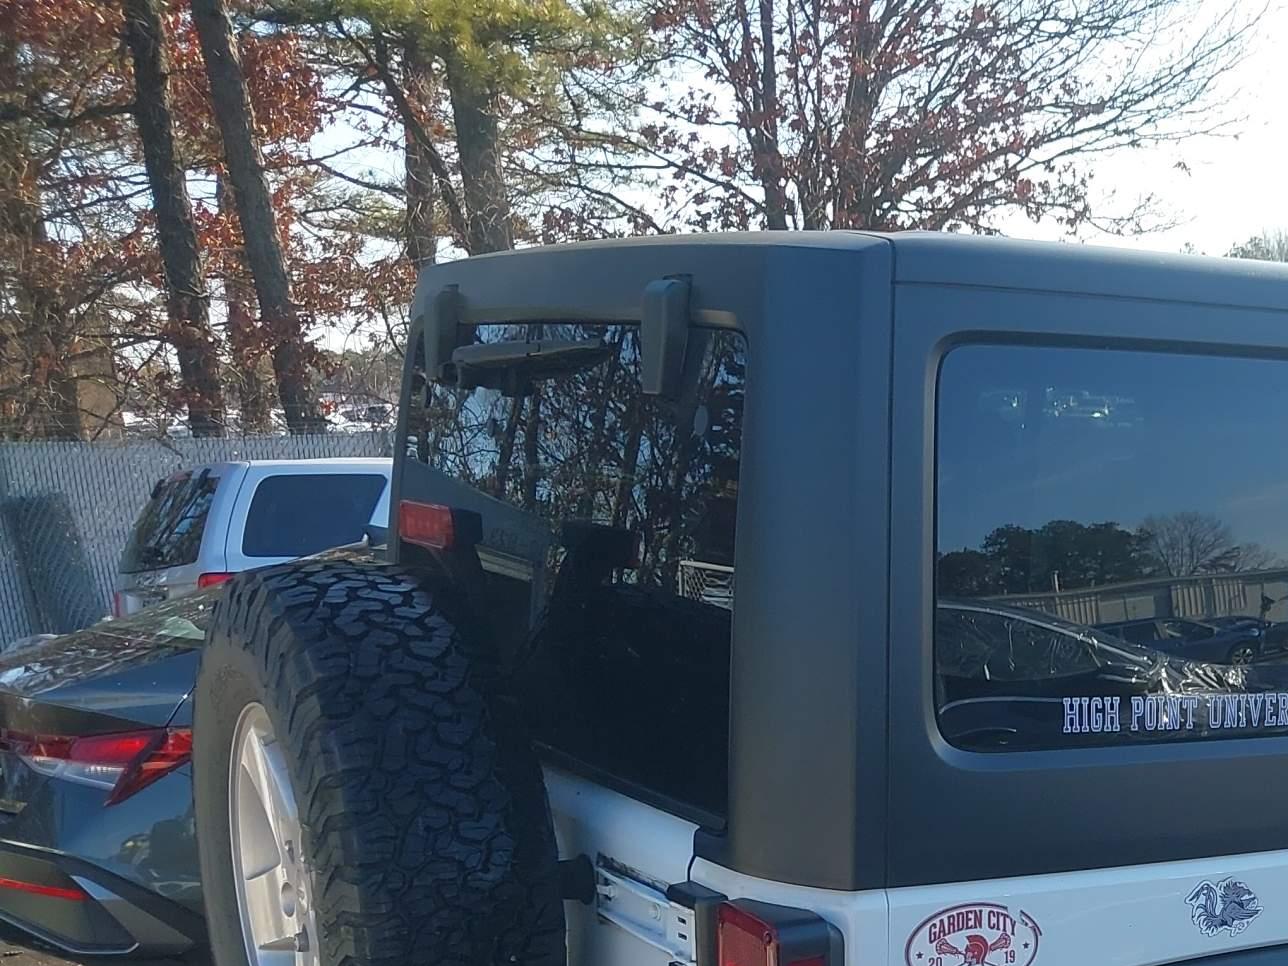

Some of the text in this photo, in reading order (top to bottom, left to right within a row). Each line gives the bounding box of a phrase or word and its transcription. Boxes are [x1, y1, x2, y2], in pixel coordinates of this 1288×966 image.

[1063, 697, 1120, 733] HIGH
[1131, 696, 1198, 731] POINT
[928, 909, 1016, 944] GARDEN CITY
[1004, 950, 1016, 964] 19
